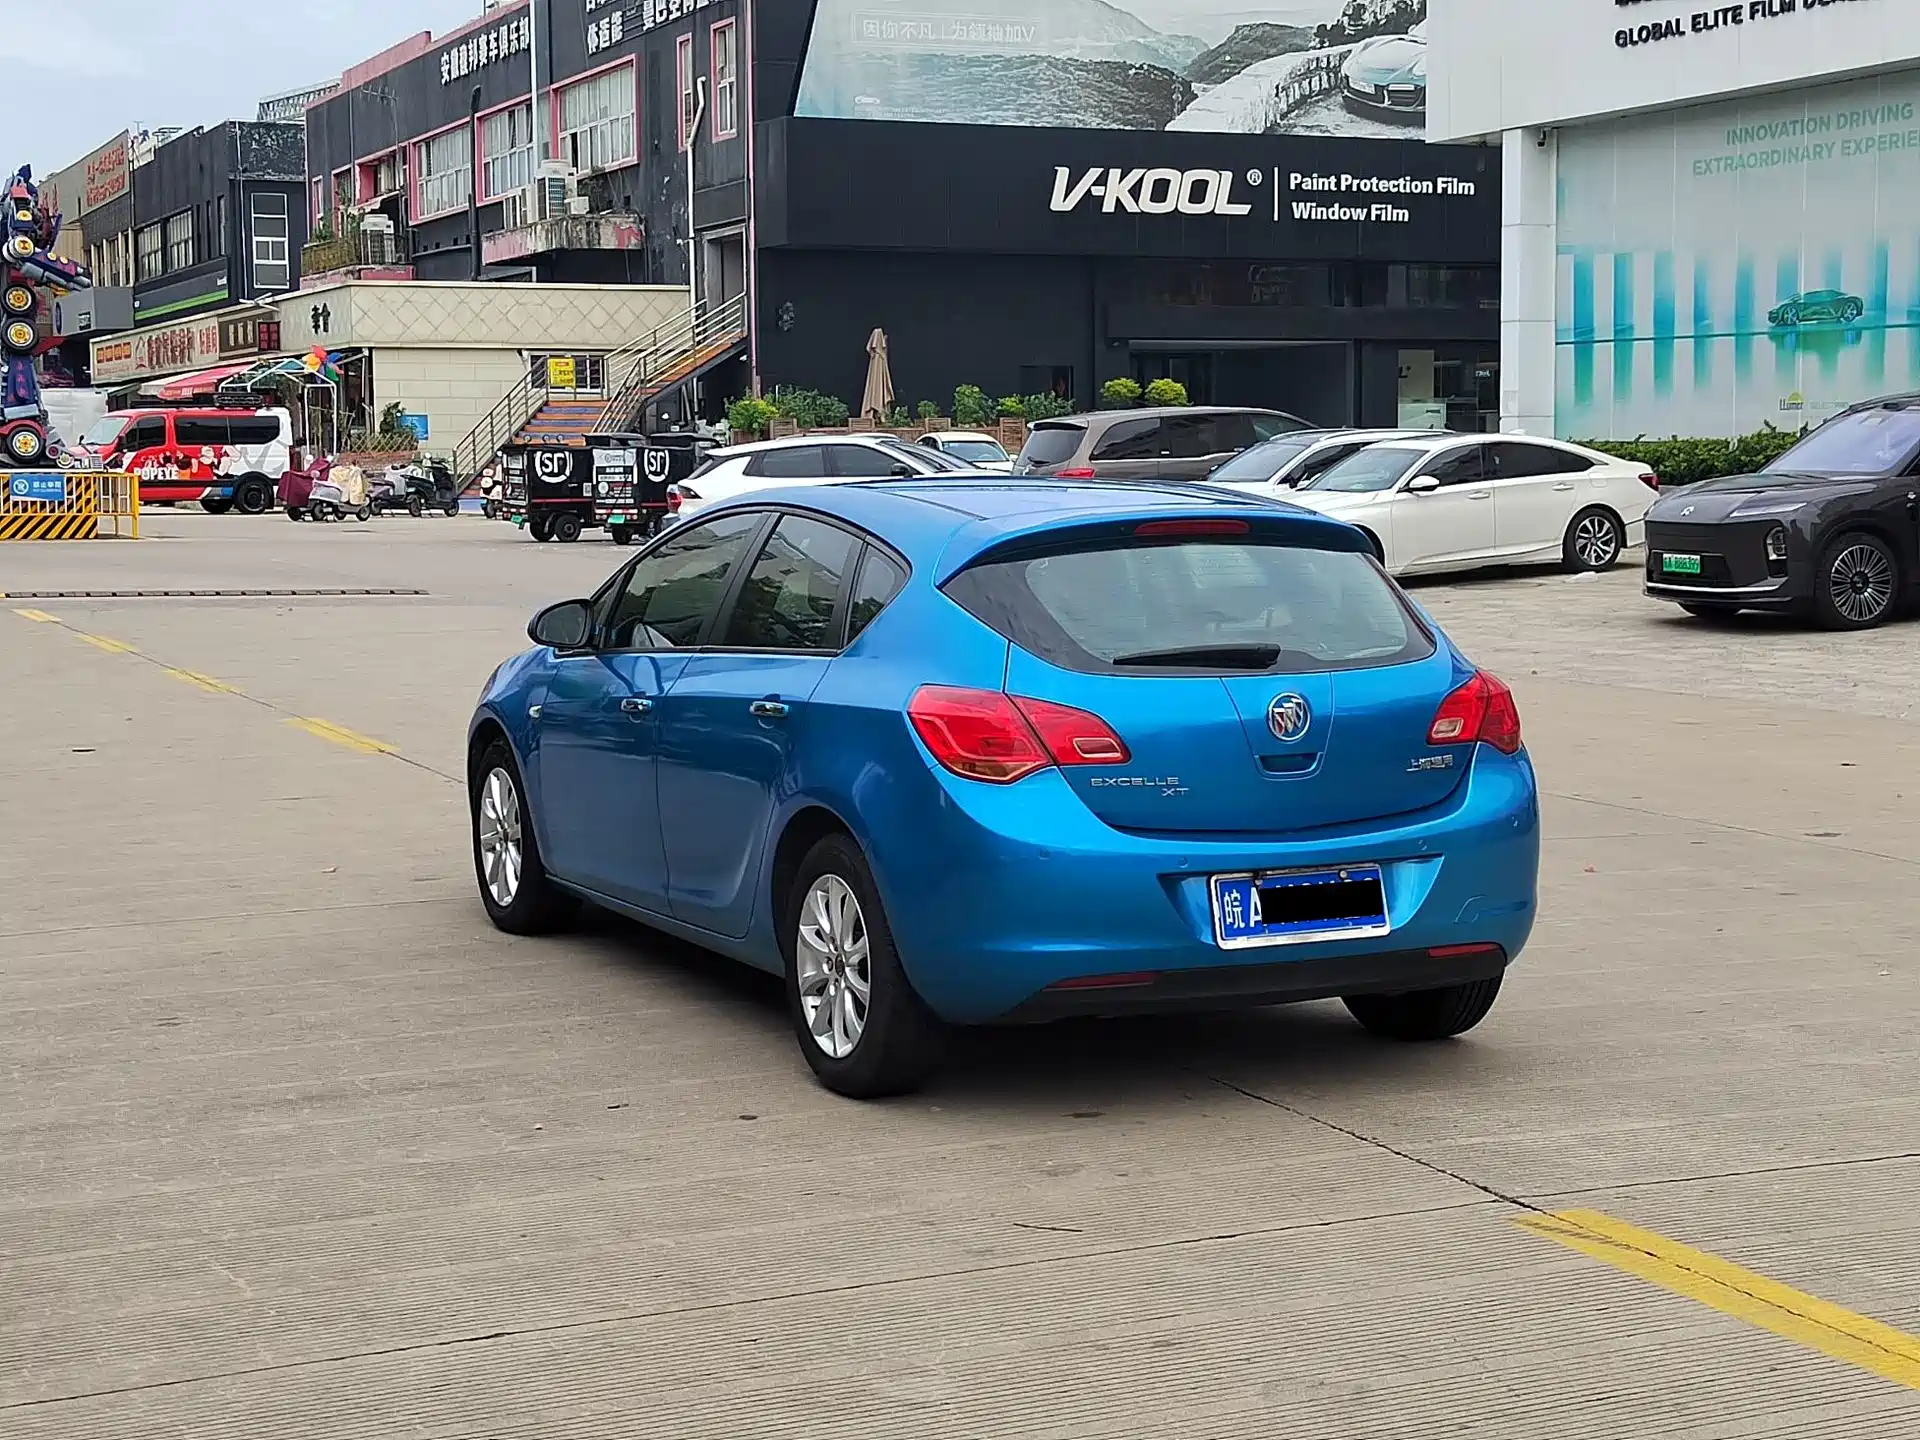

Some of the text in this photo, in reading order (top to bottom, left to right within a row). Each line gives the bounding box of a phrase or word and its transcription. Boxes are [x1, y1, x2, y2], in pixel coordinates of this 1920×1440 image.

[862, 19, 936, 40] 因你不凡
[1614, 0, 1796, 48] GLOBAL ELITE FILM
[1726, 103, 1914, 146] INNOVATION DRIVING
[1693, 130, 1920, 177] EXTRAORDINARY EXPERIE
[1050, 166, 1251, 215] V-KOOL
[1289, 172, 1475, 196] Paint Protection Film
[1291, 202, 1409, 222] Window Film
[133, 467, 179, 481] POPEYE
[1090, 777, 1180, 787] EXCELLE
[1161, 787, 1189, 797] XT
